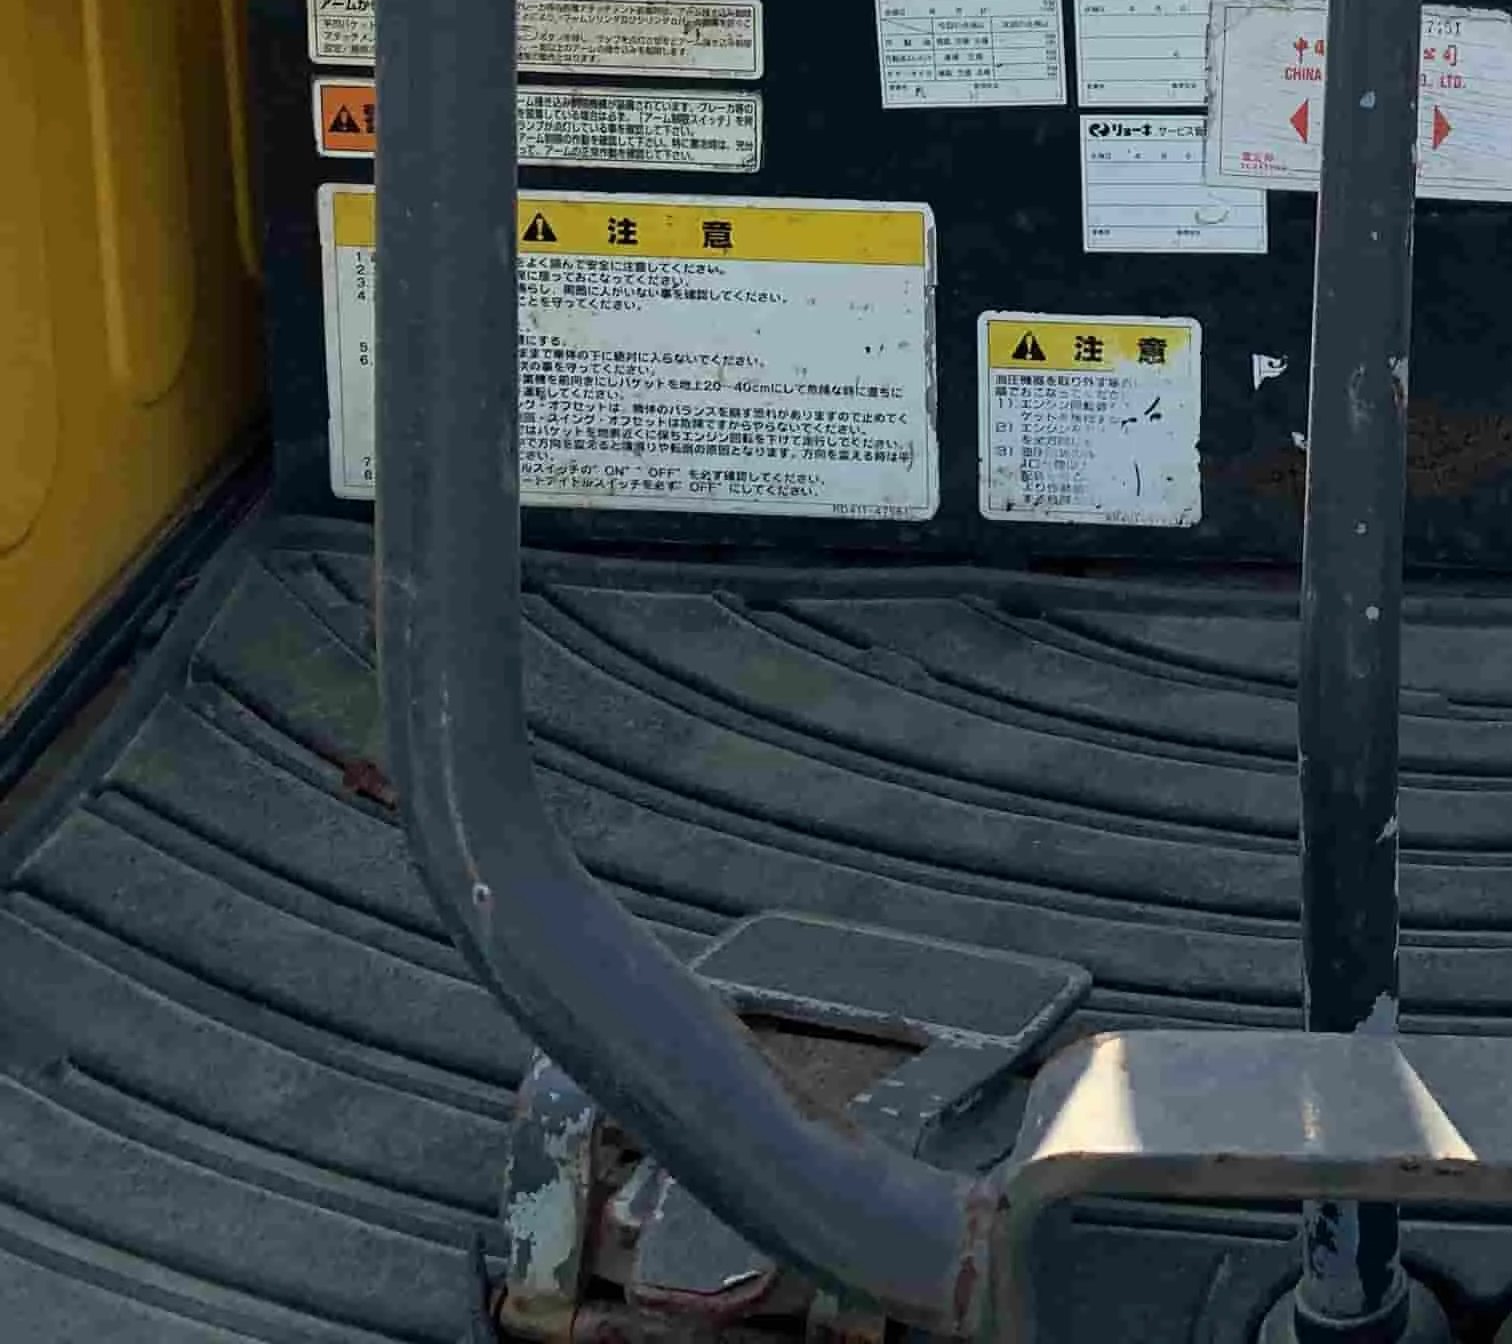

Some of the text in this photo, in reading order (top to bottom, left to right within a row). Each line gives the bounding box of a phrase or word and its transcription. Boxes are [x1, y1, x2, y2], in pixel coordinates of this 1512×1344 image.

[1284, 66, 1322, 81] CHINA
[607, 216, 733, 250] 注意
[1073, 335, 1168, 365] 注意
